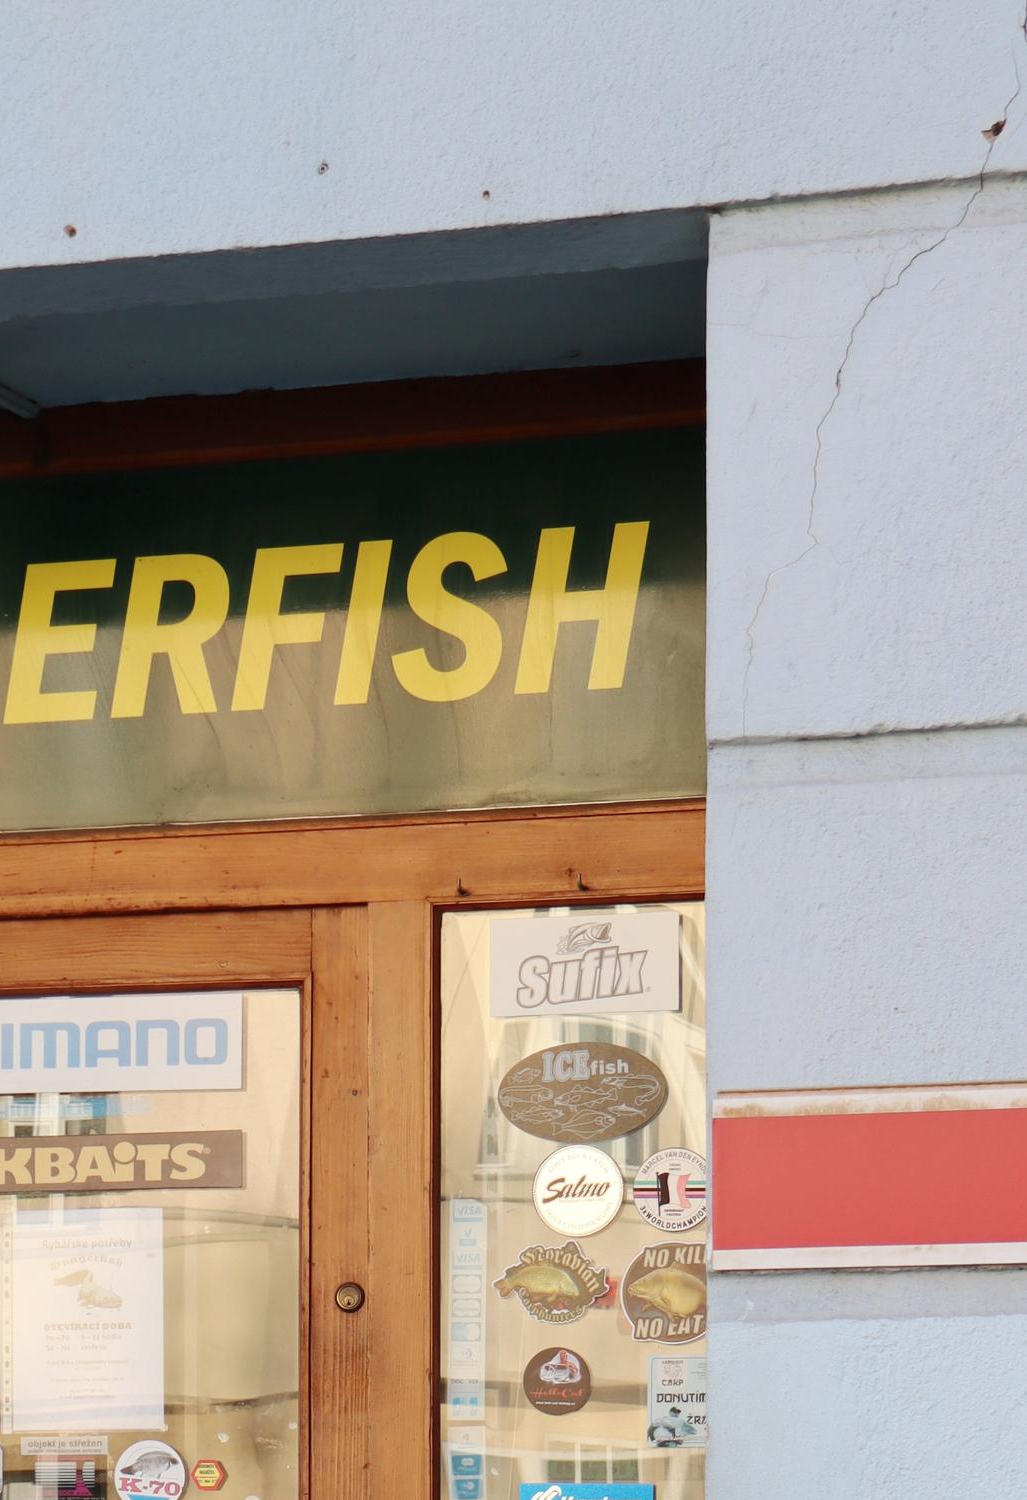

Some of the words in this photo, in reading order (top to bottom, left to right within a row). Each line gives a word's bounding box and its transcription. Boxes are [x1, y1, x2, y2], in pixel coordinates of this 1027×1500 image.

[515, 945, 648, 1009] Sufix
[541, 1049, 590, 1083] ICE
[590, 1059, 630, 1076] fish
[542, 1174, 611, 1204] Salmo
[643, 1248, 670, 1268] NO
[673, 1246, 707, 1266] KIL
[635, 1317, 663, 1339] NO
[667, 1314, 704, 1336] EAT
[28, 1440, 56, 1449] objekt
[58, 1439, 67, 1449] je
[118, 1477, 181, 1496] K-70
